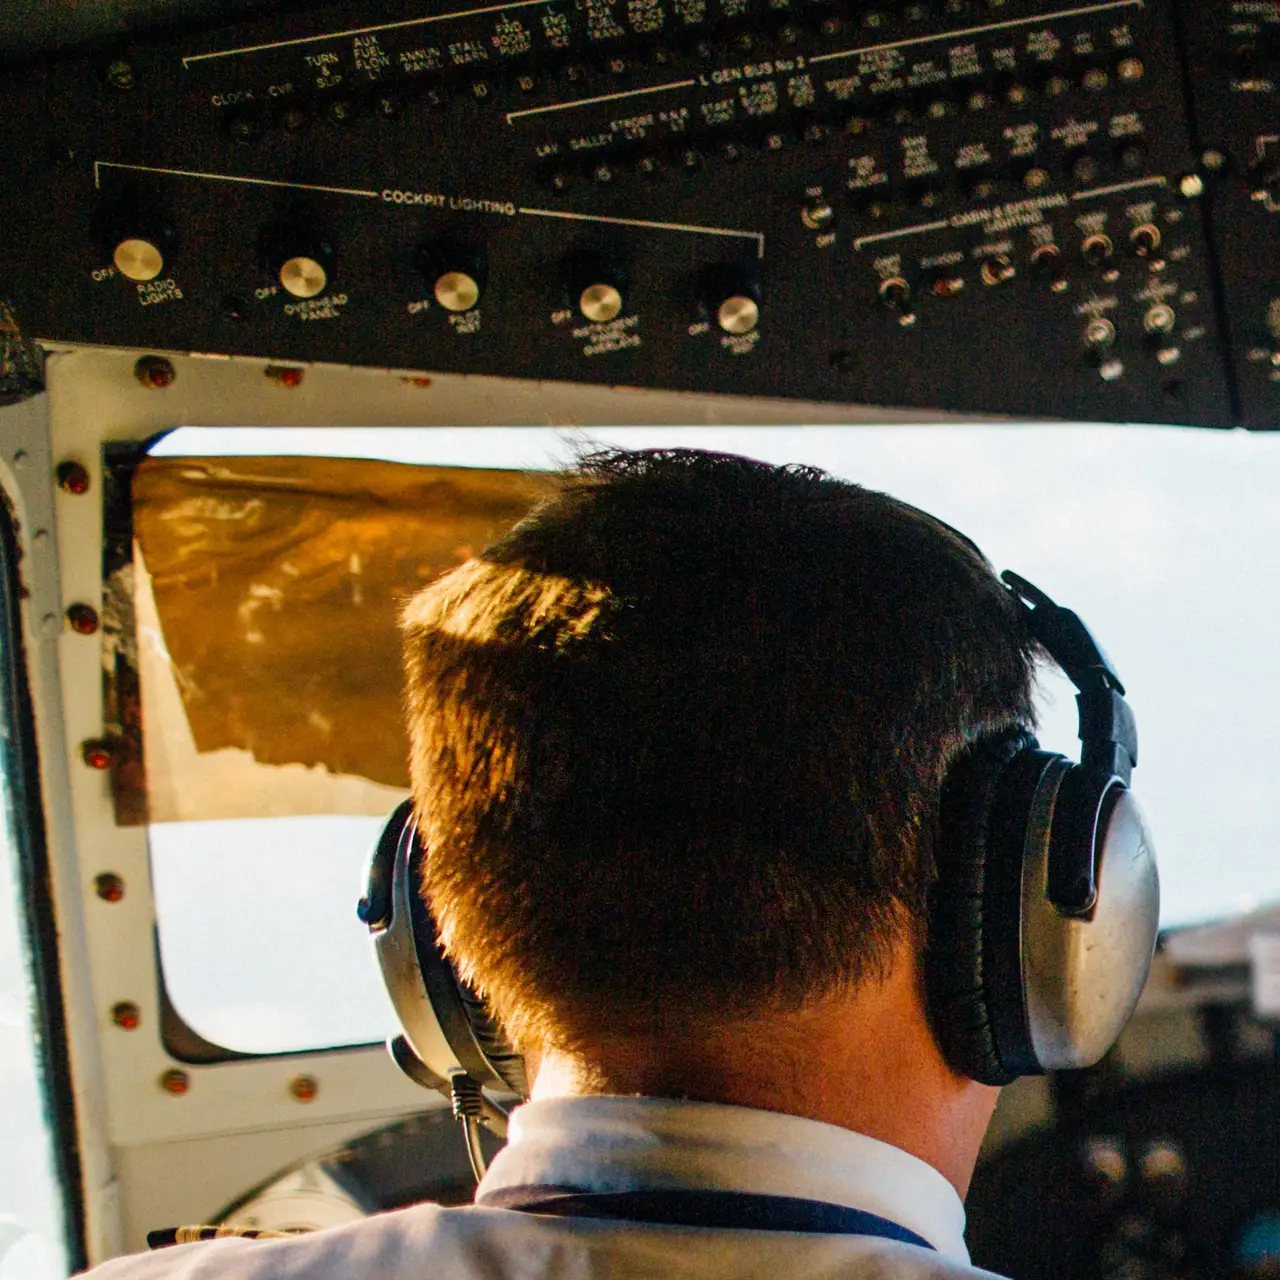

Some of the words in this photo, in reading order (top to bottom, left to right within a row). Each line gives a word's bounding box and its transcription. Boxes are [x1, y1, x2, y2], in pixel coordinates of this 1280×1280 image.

[352, 36, 379, 48] AUX
[447, 40, 485, 56] STALL
[303, 52, 338, 68] TURN
[353, 47, 384, 60] FUEL
[451, 51, 489, 66] WARN
[354, 56, 391, 71] FLOW
[315, 74, 343, 89] SLIP
[697, 74, 709, 87] L
[709, 67, 742, 85] GEN
[210, 89, 256, 108] CLOCK
[472, 83, 489, 98] 10
[381, 188, 446, 208] COCKPIT
[449, 194, 517, 217] LIGHTING
[91, 267, 116, 283] OFF
[136, 278, 175, 296] RADIO
[254, 285, 279, 301] OFF
[137, 288, 184, 308] LIGHTS
[283, 292, 348, 317] OVERHEAD
[298, 306, 341, 322] PANEL
[405, 298, 430, 315] OFF
[549, 308, 571, 326] OFF
